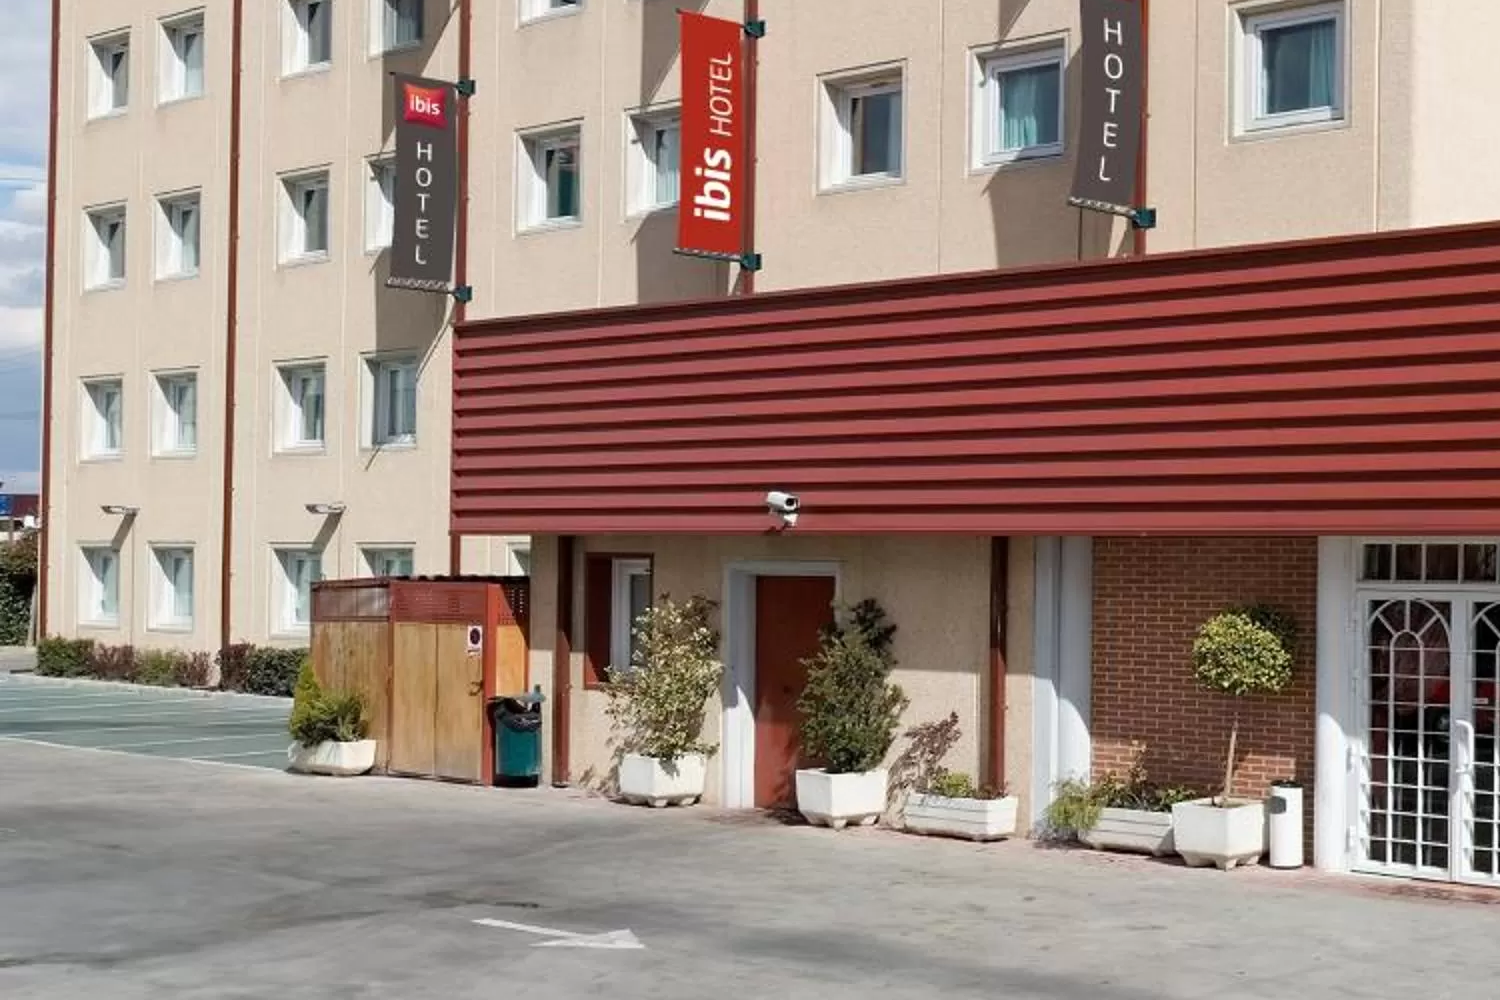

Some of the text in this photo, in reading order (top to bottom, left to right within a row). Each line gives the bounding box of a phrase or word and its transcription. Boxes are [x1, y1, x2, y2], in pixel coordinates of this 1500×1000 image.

[409, 94, 441, 116] ibis
[694, 52, 733, 222] ibis HOTEL
[1099, 17, 1123, 181] HOTEL
[415, 140, 433, 266] HOTEL
